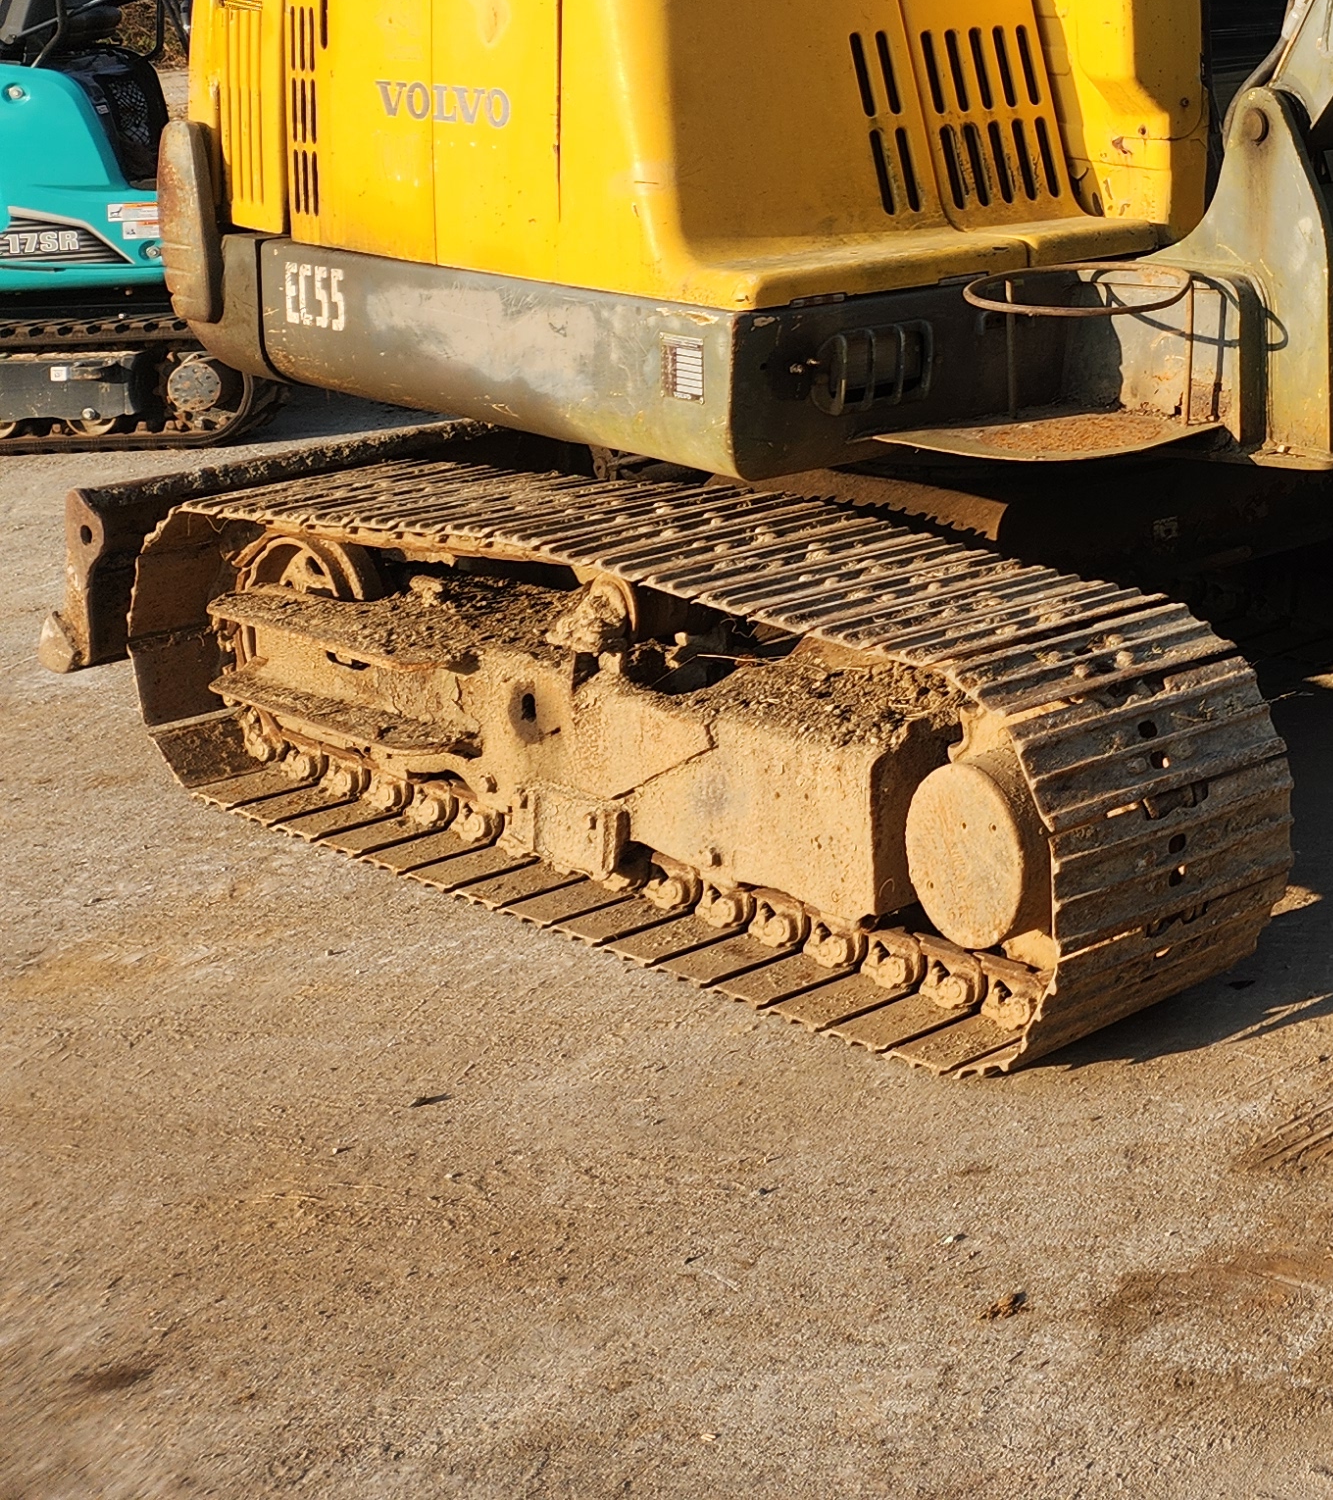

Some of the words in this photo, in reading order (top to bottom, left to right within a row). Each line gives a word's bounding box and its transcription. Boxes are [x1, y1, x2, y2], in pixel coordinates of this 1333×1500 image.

[375, 80, 510, 128] VOLVO
[3, 230, 79, 254] 17SR
[284, 261, 345, 332] EC55
